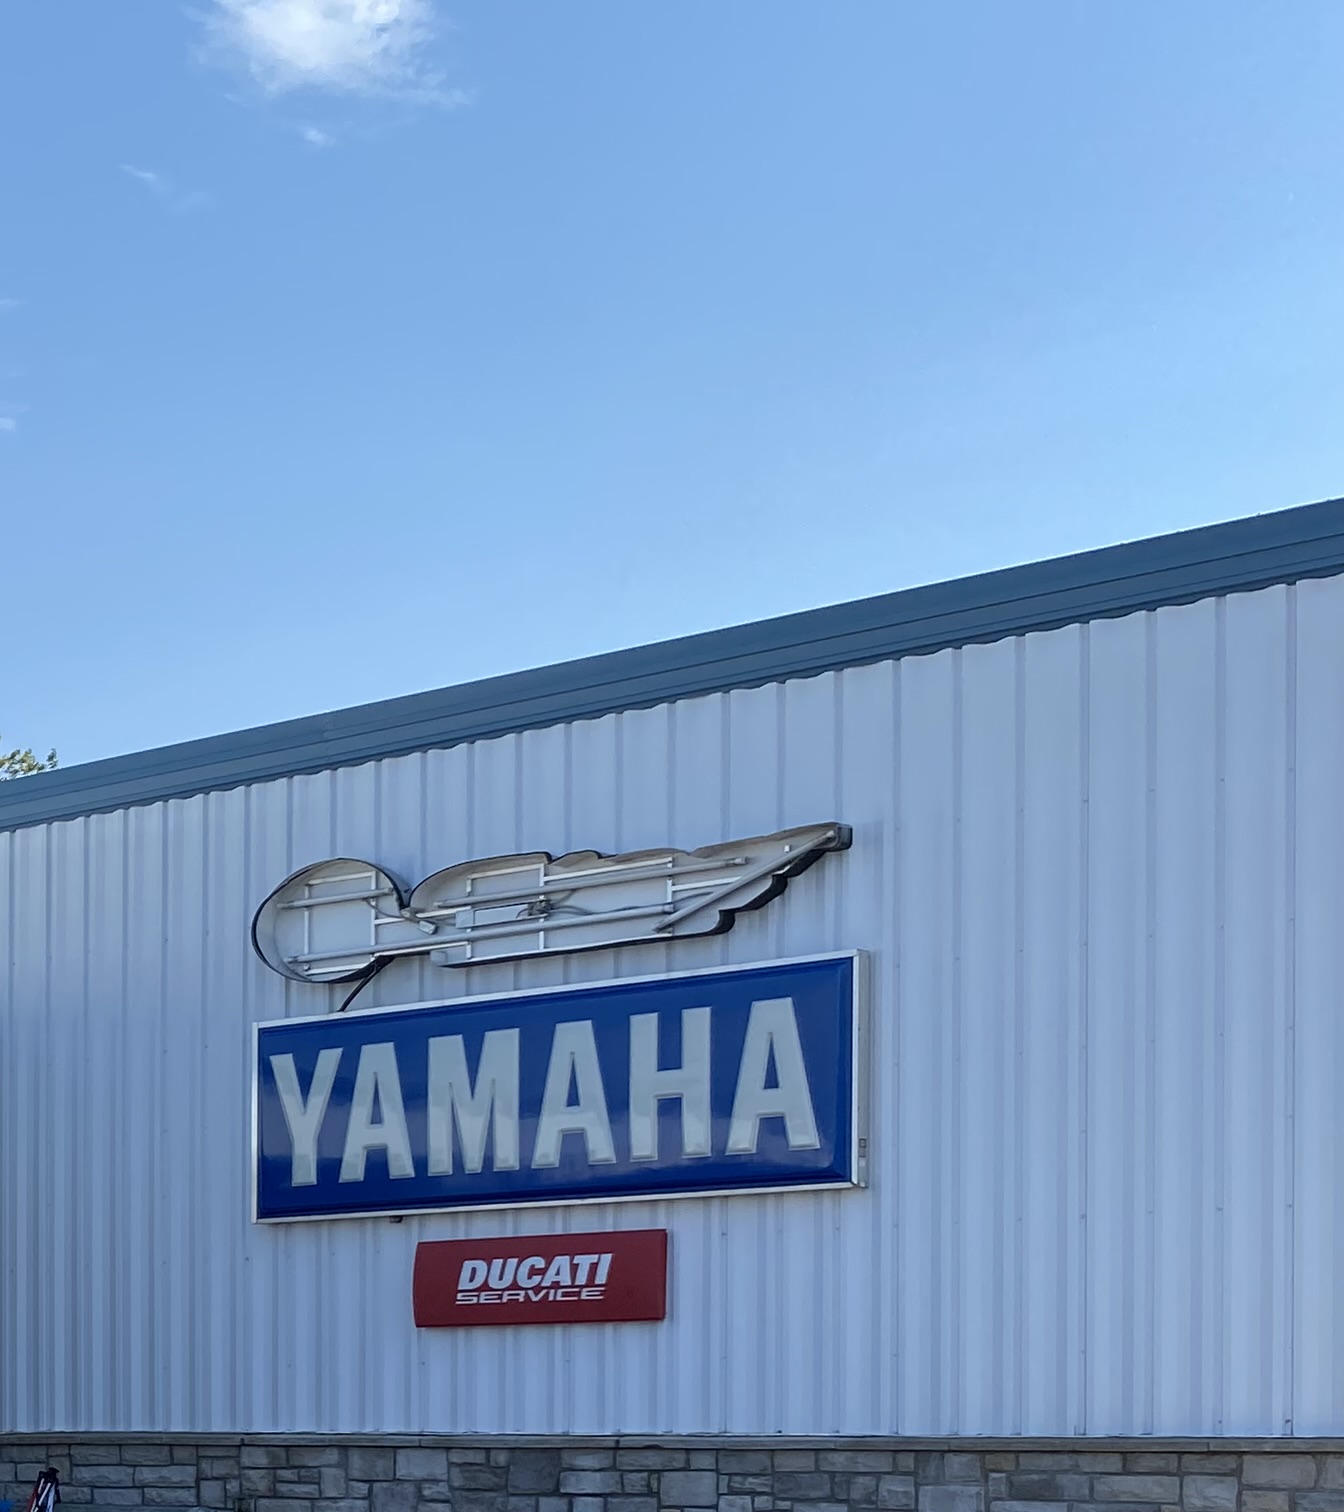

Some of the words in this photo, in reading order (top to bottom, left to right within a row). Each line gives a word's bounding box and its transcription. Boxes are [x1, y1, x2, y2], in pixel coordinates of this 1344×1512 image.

[269, 996, 820, 1187] YAMAHA
[457, 1253, 613, 1290] DUCATI
[454, 1287, 605, 1305] SERVICE
